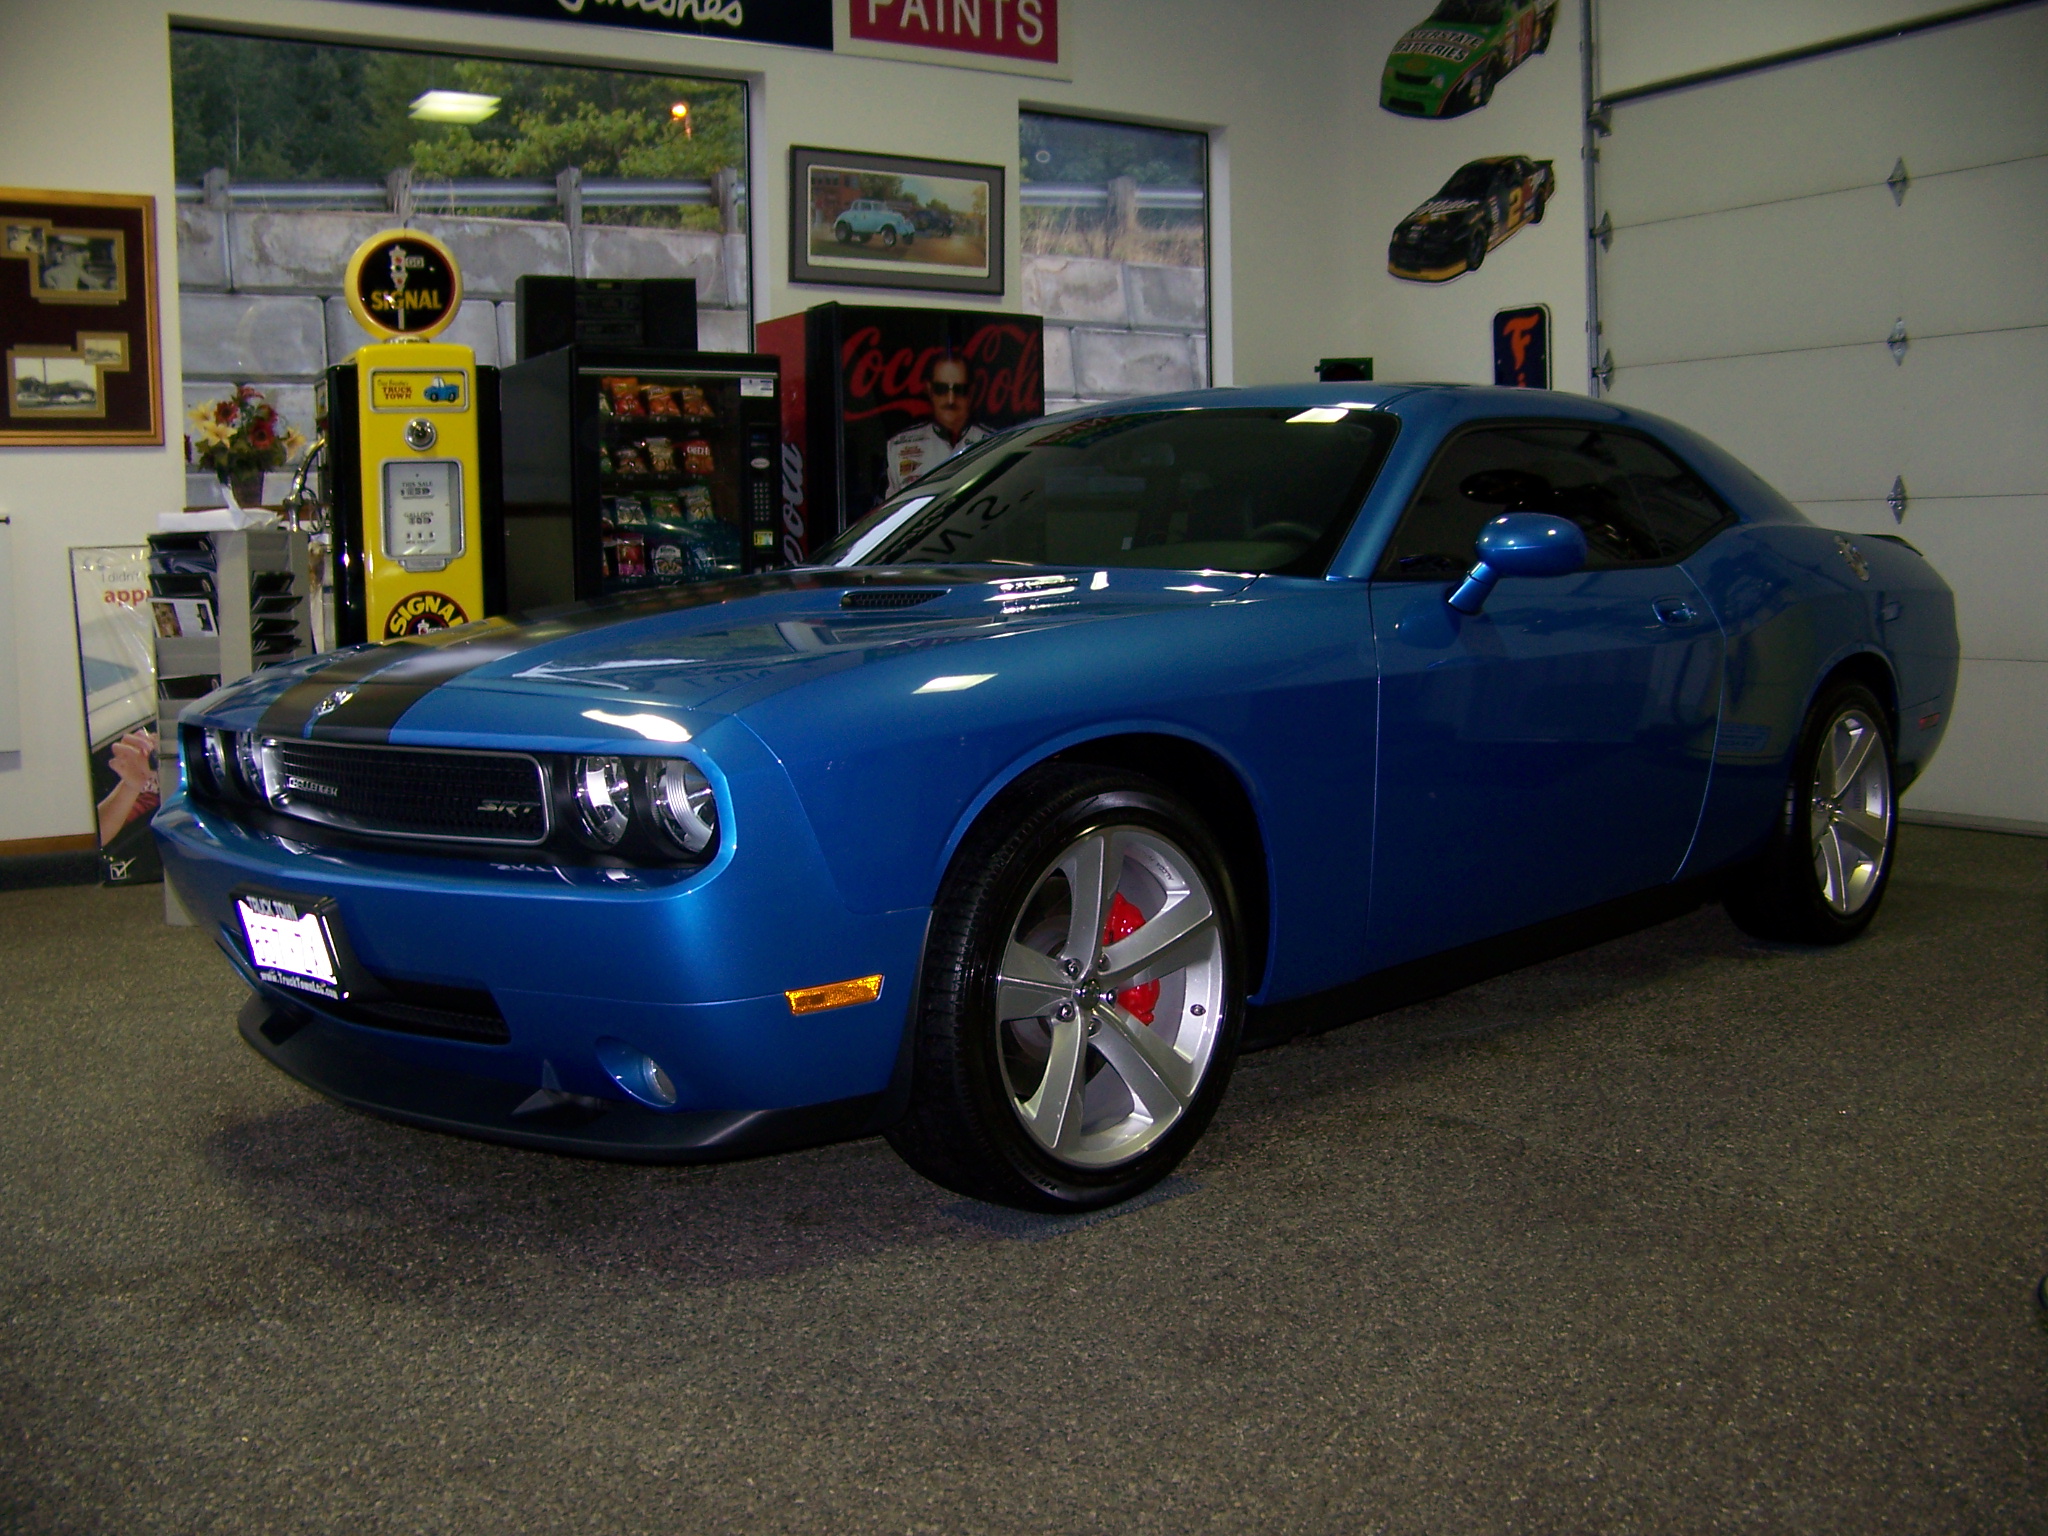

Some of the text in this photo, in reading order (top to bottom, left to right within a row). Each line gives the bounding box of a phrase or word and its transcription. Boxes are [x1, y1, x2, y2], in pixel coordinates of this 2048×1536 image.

[868, 0, 1044, 45] PAINTS
[371, 289, 442, 310] SIGNAL
[477, 800, 541, 818] SRT
